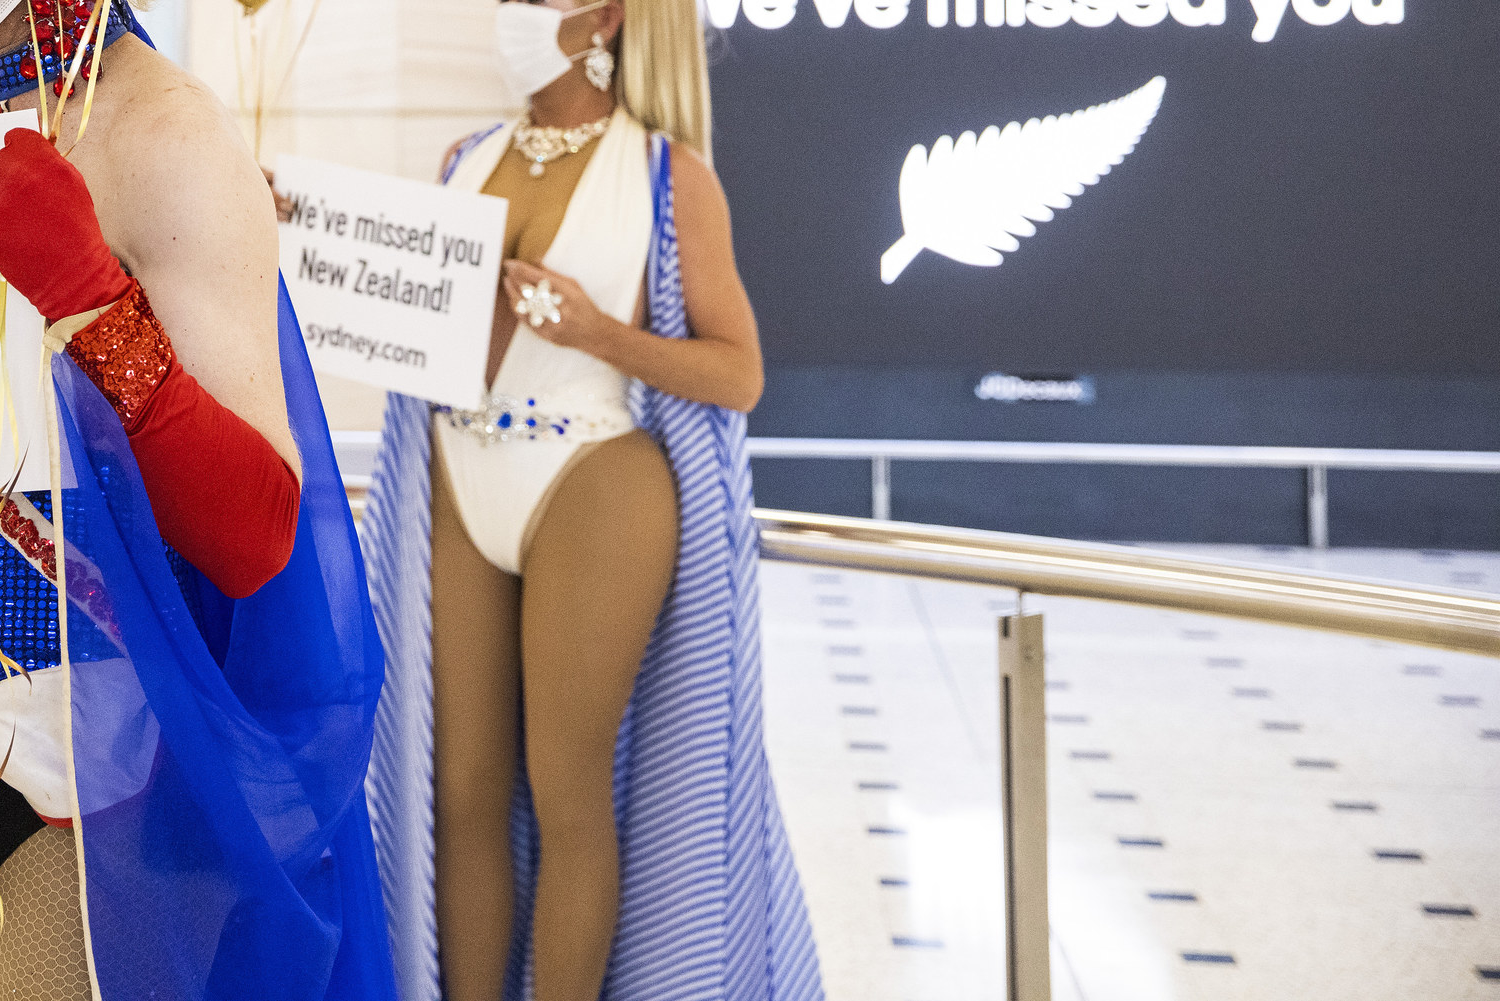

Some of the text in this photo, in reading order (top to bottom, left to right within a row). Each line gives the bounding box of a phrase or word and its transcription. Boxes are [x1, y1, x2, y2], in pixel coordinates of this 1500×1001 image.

[353, 213, 436, 256] missed
[440, 234, 483, 267] you
[299, 248, 453, 313] New Zealand!
[306, 323, 426, 367] sydney.com
